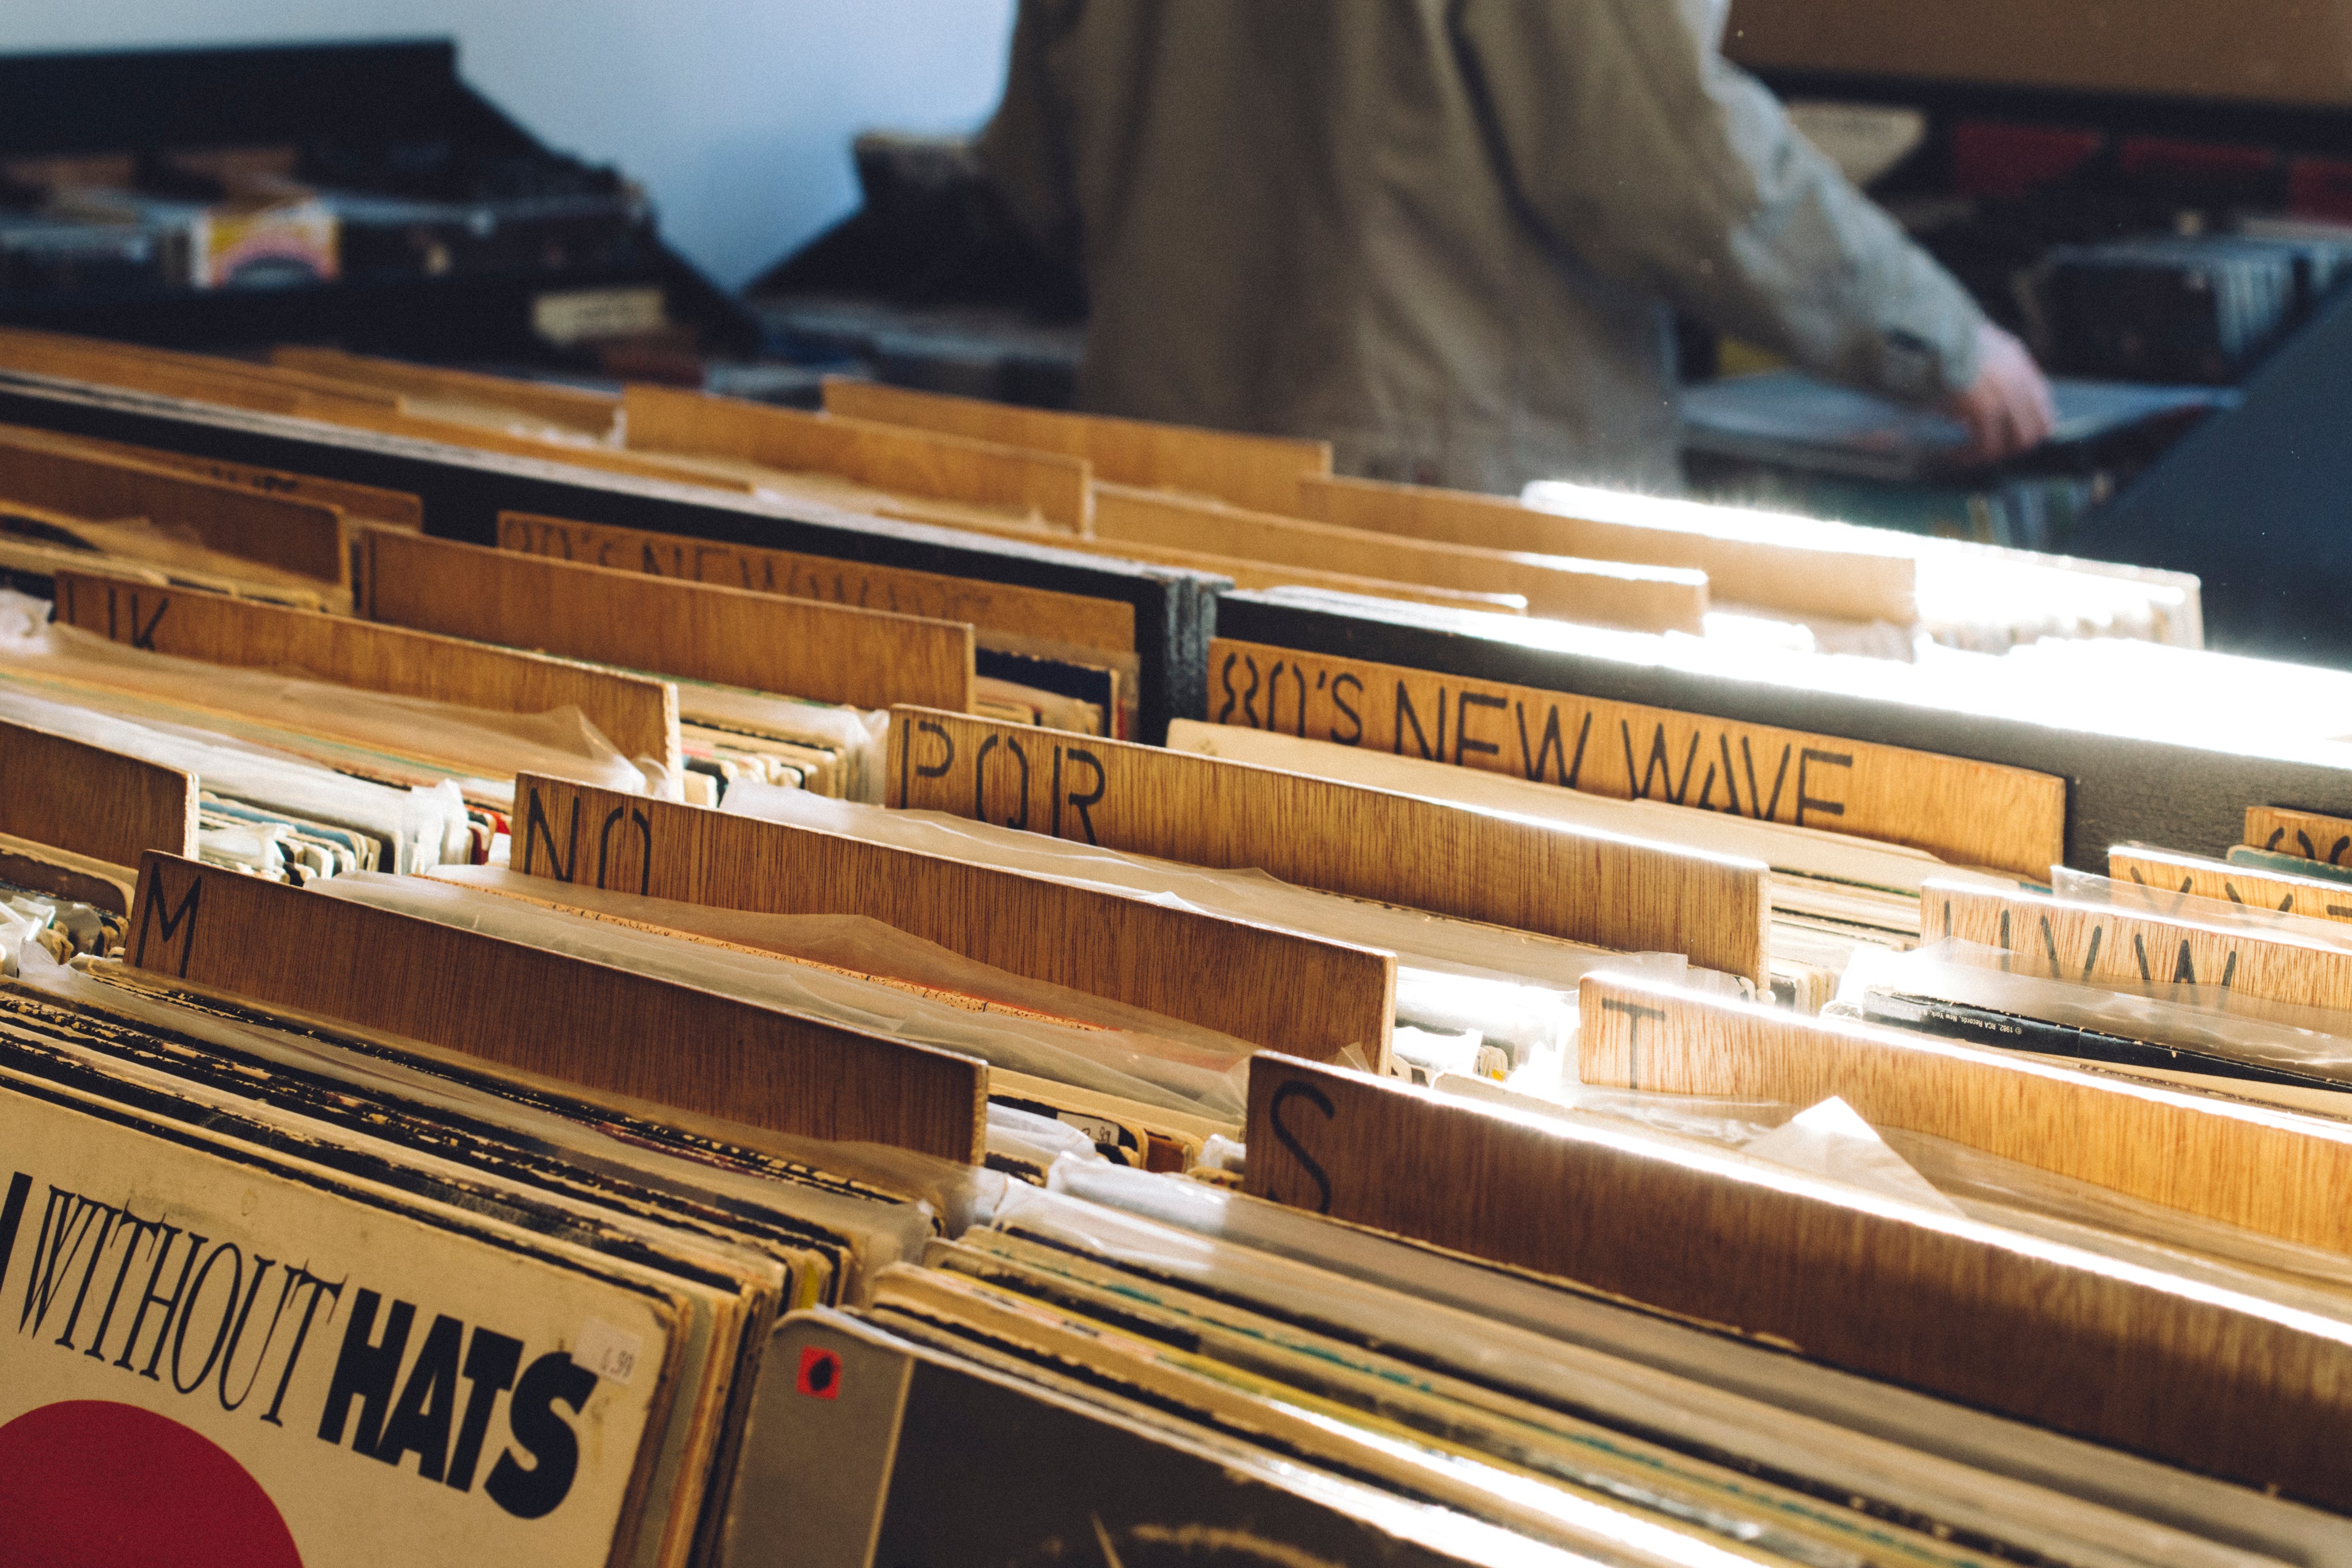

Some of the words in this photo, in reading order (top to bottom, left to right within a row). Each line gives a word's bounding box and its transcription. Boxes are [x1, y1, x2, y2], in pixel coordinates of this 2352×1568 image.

[1221, 652, 1364, 745] 80'S
[1395, 680, 1591, 789] NEW
[1621, 720, 1854, 827] WAVE
[135, 862, 201, 979] M
[1601, 998, 1666, 1089] T
[1946, 1013, 1958, 1022] New
[1984, 1021, 1997, 1030] RCA
[1269, 1079, 1335, 1215] S
[18, 1184, 349, 1428] WITHOUT
[317, 1288, 599, 1520] HATS
